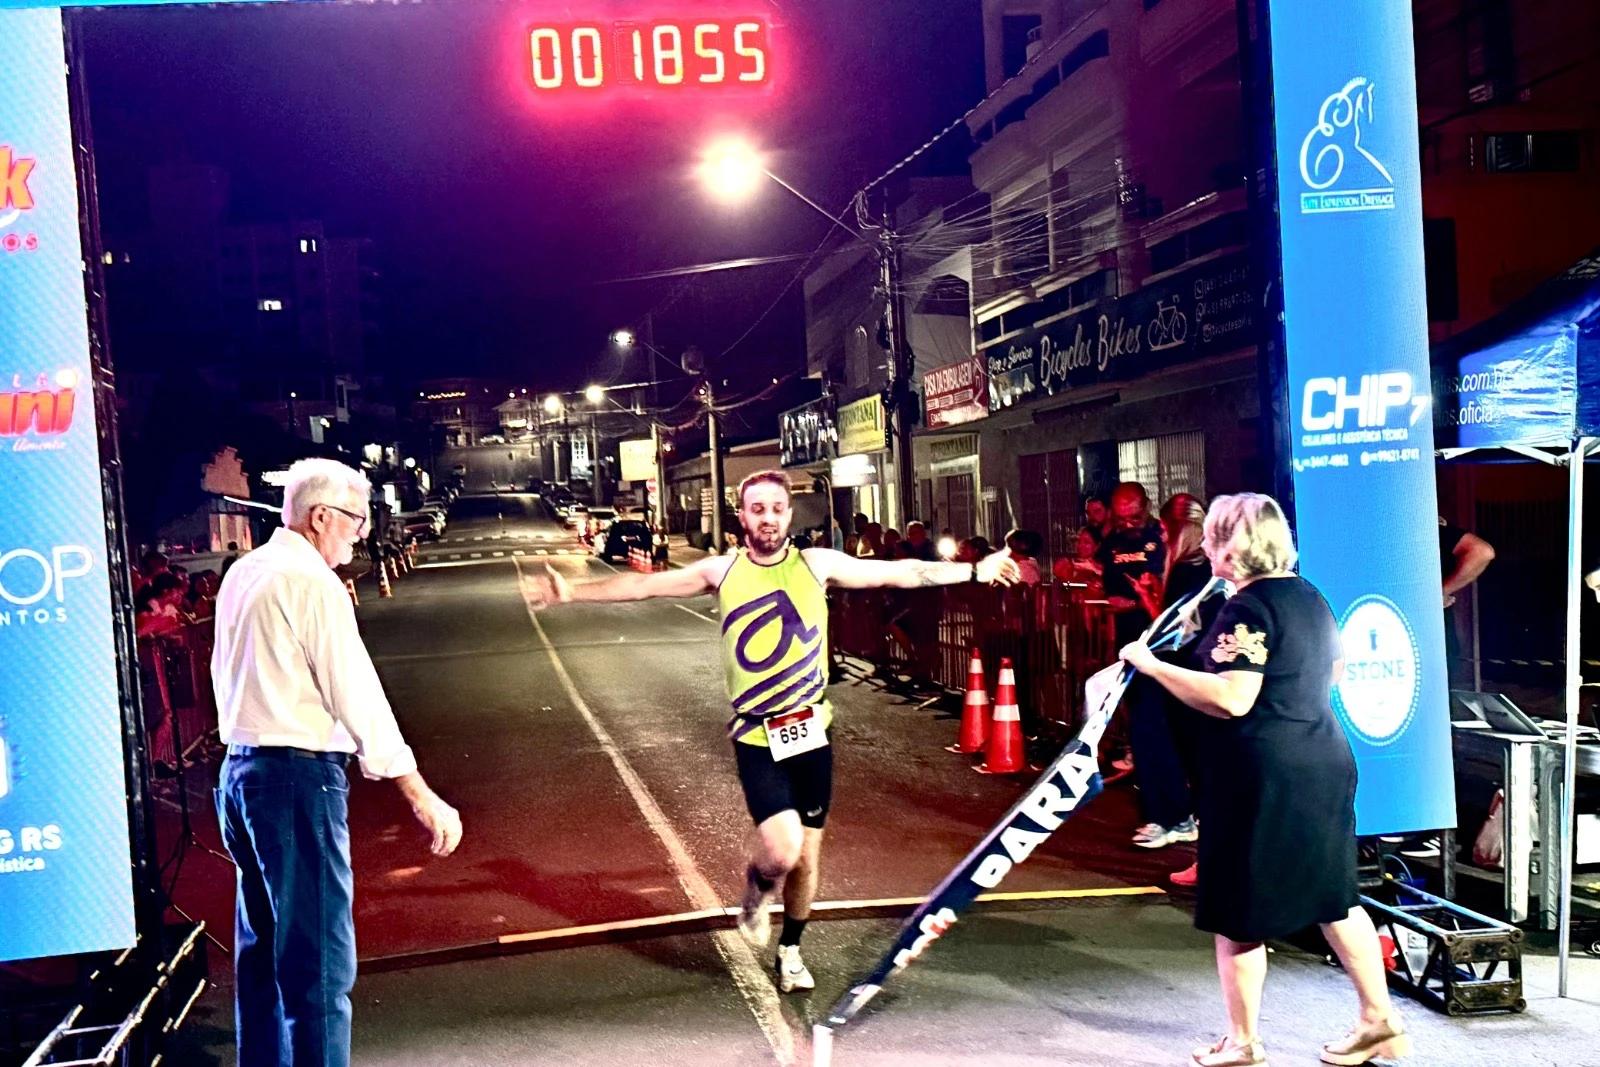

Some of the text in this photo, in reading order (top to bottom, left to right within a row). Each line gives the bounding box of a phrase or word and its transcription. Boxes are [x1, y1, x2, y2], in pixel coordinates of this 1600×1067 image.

[1040, 335, 1092, 387] Bicycles
[1098, 314, 1142, 372] Bikes
[0, 545, 93, 605] OP
[1346, 659, 1406, 681] STONE
[780, 722, 808, 744] 693
[21, 824, 63, 852] RS
